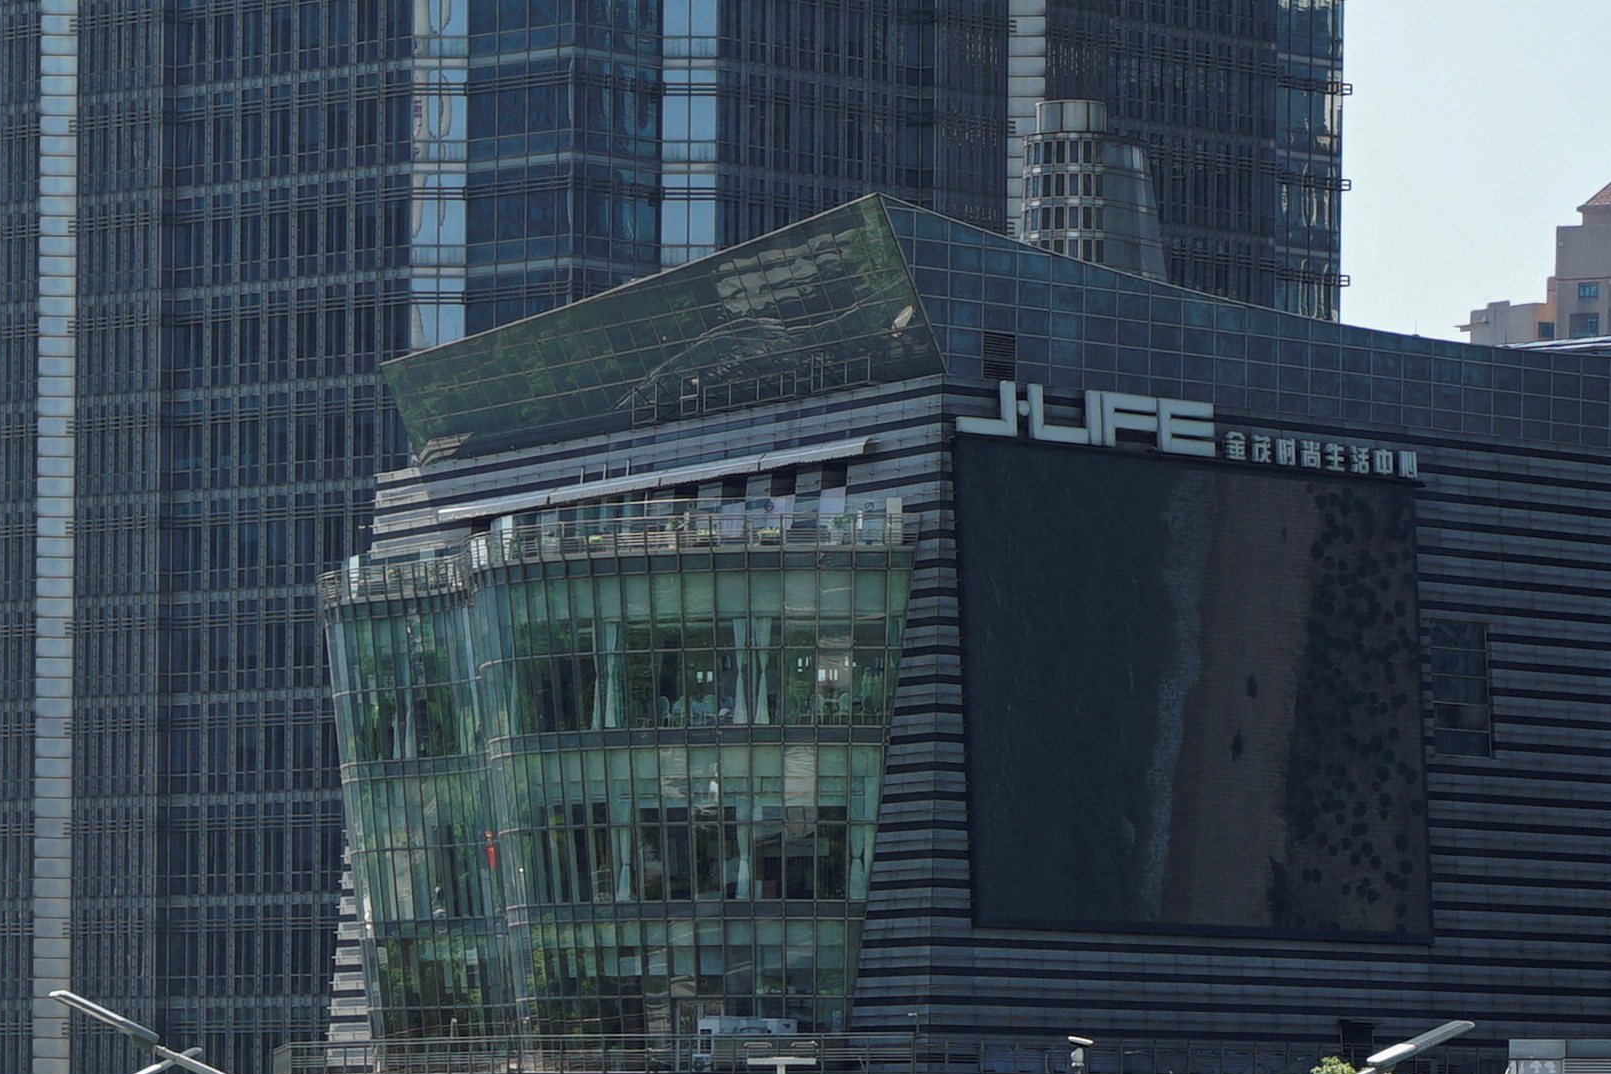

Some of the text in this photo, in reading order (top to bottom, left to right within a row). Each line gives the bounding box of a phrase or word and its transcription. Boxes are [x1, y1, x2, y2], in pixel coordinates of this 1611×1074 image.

[1225, 431, 1418, 479] 金茂时尚生活中心
